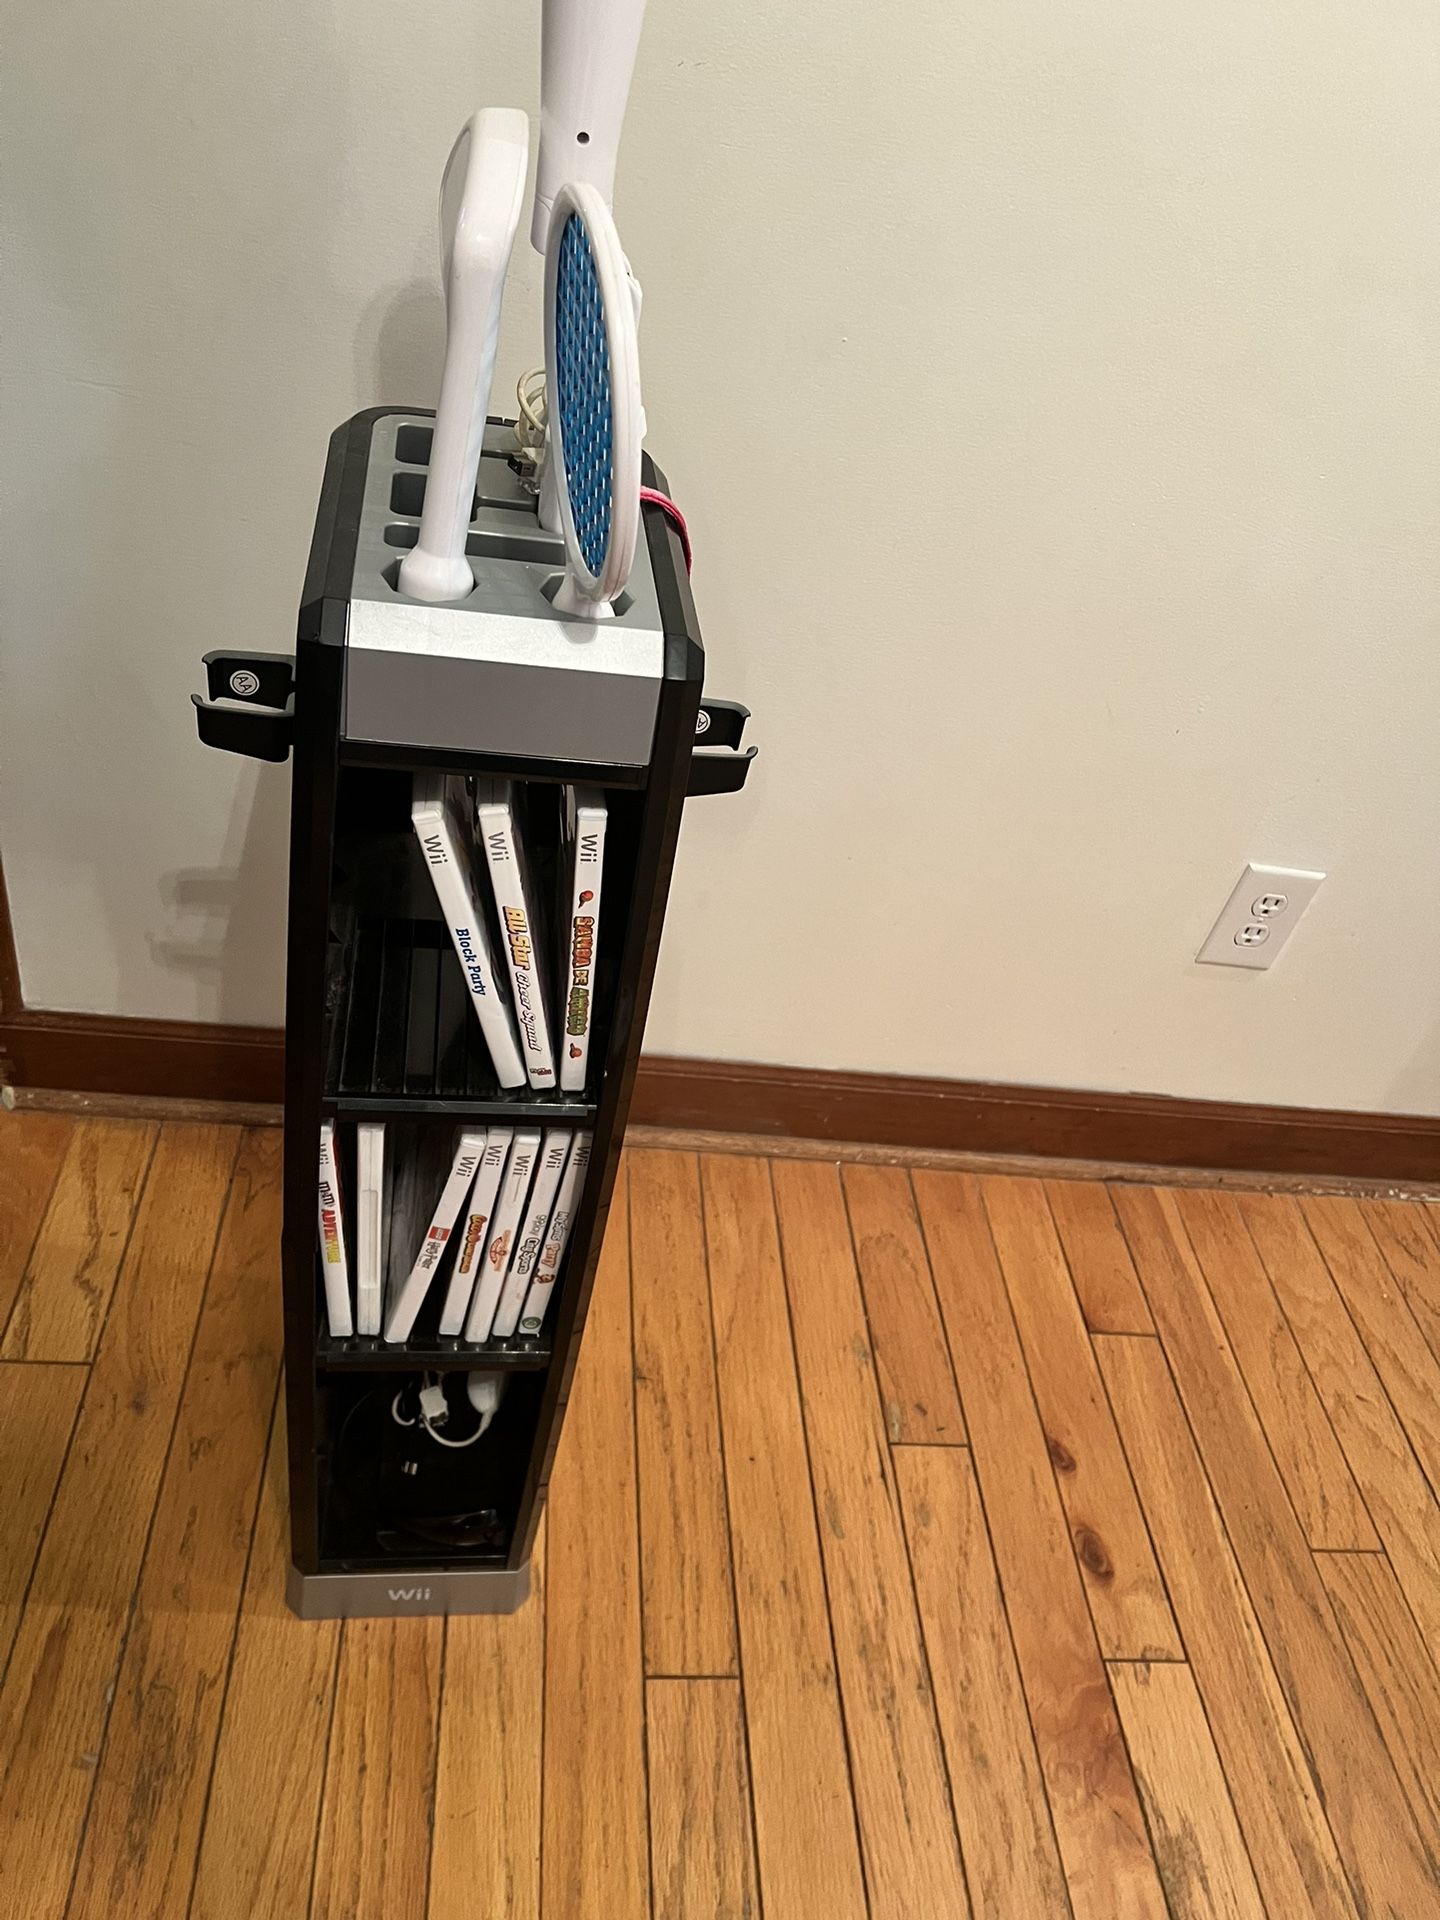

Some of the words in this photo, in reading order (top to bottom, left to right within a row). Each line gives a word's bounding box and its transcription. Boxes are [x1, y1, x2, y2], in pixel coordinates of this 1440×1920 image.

[423, 834, 448, 865] Wii
[488, 831, 509, 862] Wii
[581, 833, 597, 863] Wii
[502, 906, 528, 934] All
[508, 934, 533, 971] Star
[572, 915, 595, 969] SAMBA
[455, 928, 474, 962] Block
[468, 964, 486, 996] Party
[515, 971, 533, 1010] Cheer
[573, 969, 589, 986] DE
[521, 1010, 542, 1052] Squad
[455, 1155, 477, 1178] Wii
[484, 1144, 503, 1166] Wii
[512, 1154, 531, 1176] Wii
[545, 1147, 564, 1169] Wii
[572, 1145, 591, 1168] Wii
[388, 1587, 432, 1601] Wii
